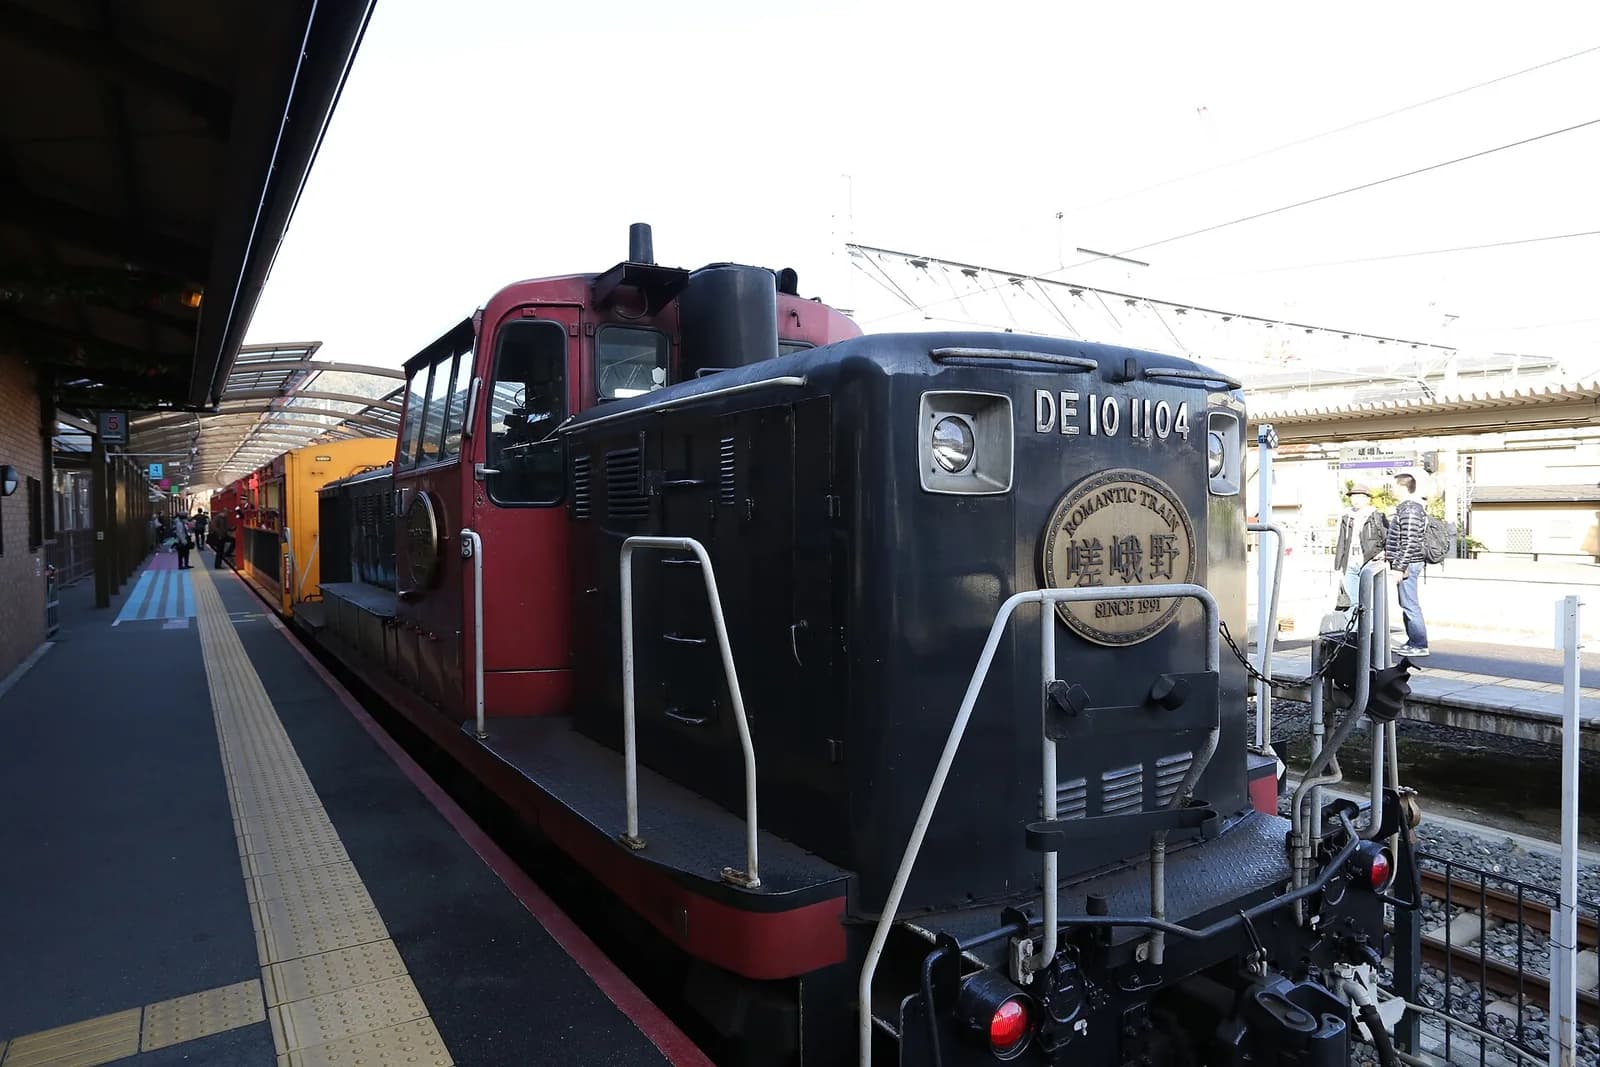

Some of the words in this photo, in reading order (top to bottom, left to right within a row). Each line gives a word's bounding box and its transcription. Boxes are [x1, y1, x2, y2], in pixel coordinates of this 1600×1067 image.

[108, 416, 119, 431] 5
[1131, 398, 1190, 440] 1104
[1062, 487, 1137, 538] ROMANTIC
[1140, 490, 1180, 533] TRAIN
[1066, 533, 1180, 587] 嵯峨野
[1095, 599, 1134, 619] SINCE
[1137, 599, 1161, 614] 1991
